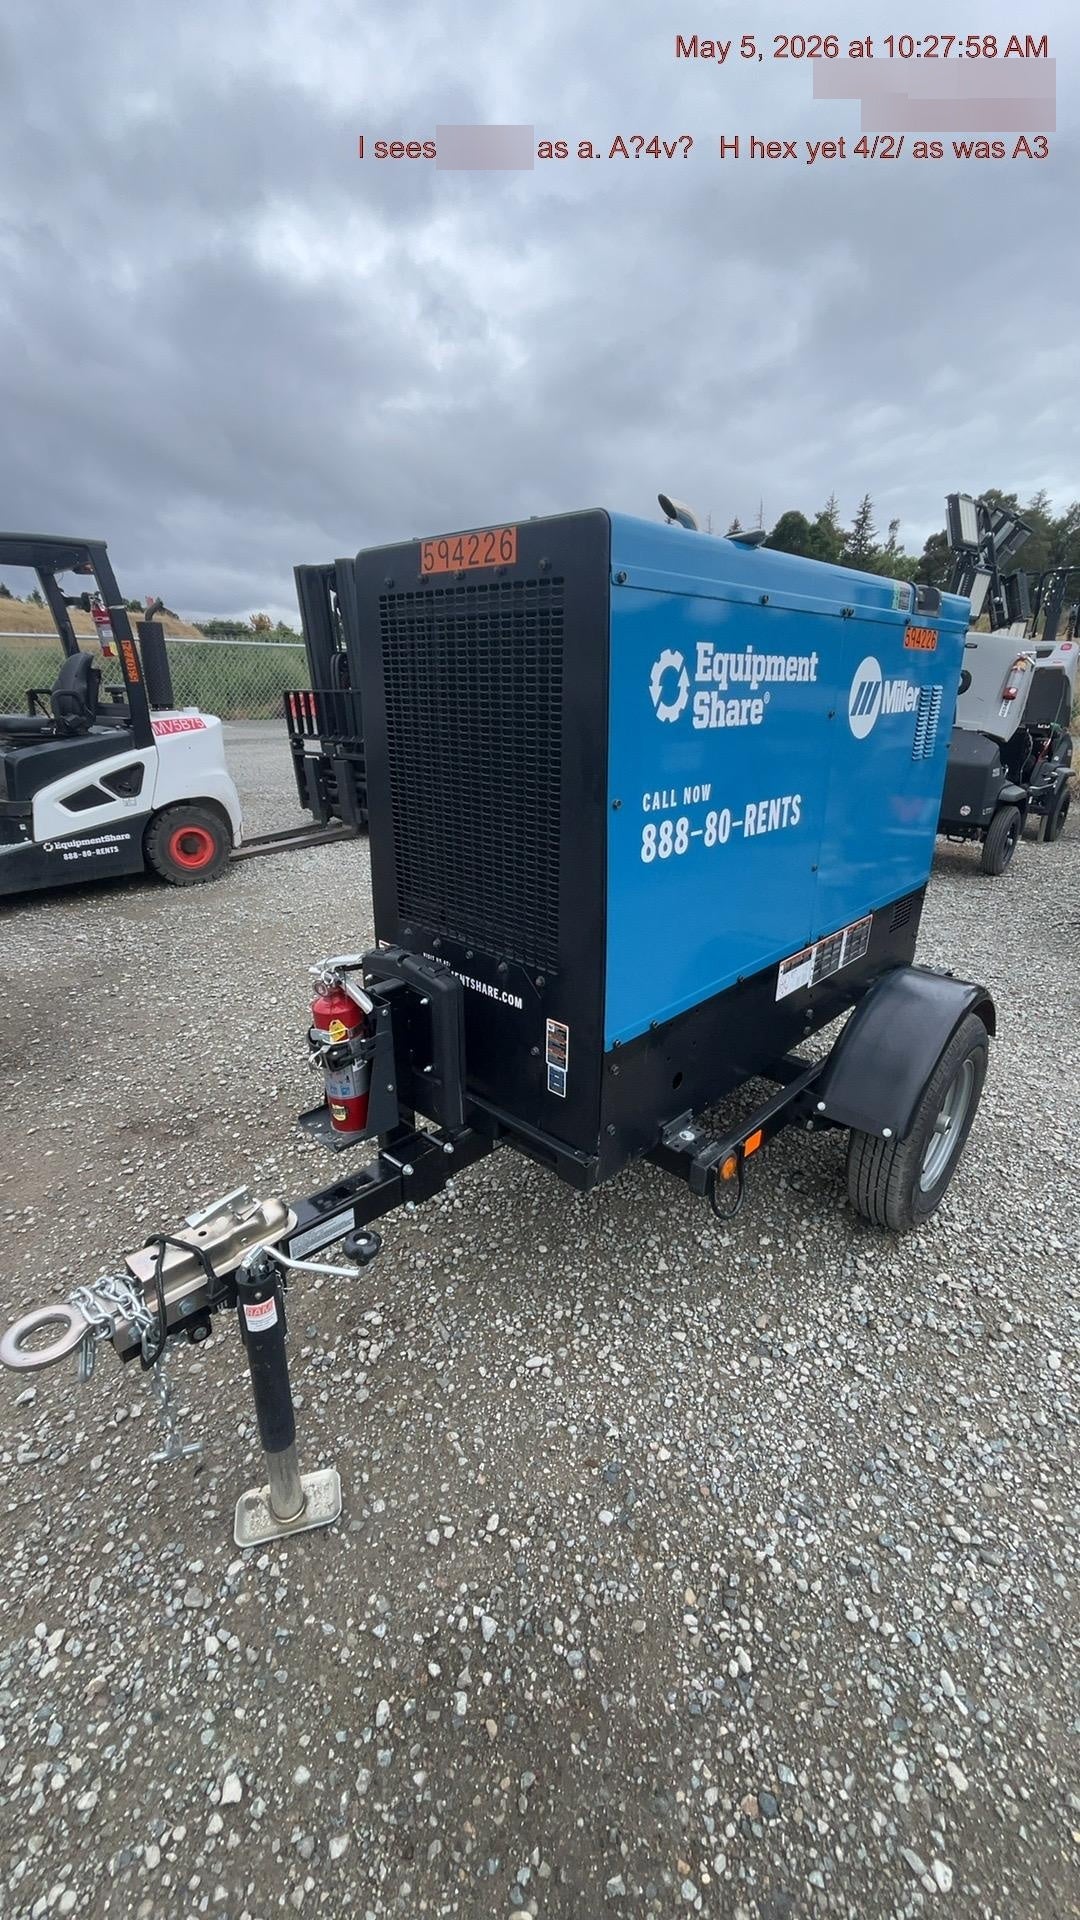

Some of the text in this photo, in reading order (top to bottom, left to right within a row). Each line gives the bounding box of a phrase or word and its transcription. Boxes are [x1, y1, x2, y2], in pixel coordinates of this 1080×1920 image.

[423, 529, 513, 571] 594226
[905, 626, 937, 650] 594226
[695, 641, 819, 690] Equipment
[881, 679, 921, 714] Miller
[152, 718, 205, 735] MV5B75
[642, 783, 712, 812] CALL NOW
[54, 832, 131, 850] EquipmentShare
[640, 794, 802, 864] 888-80-RENTS
[63, 845, 119, 861] 888-80-RENTS
